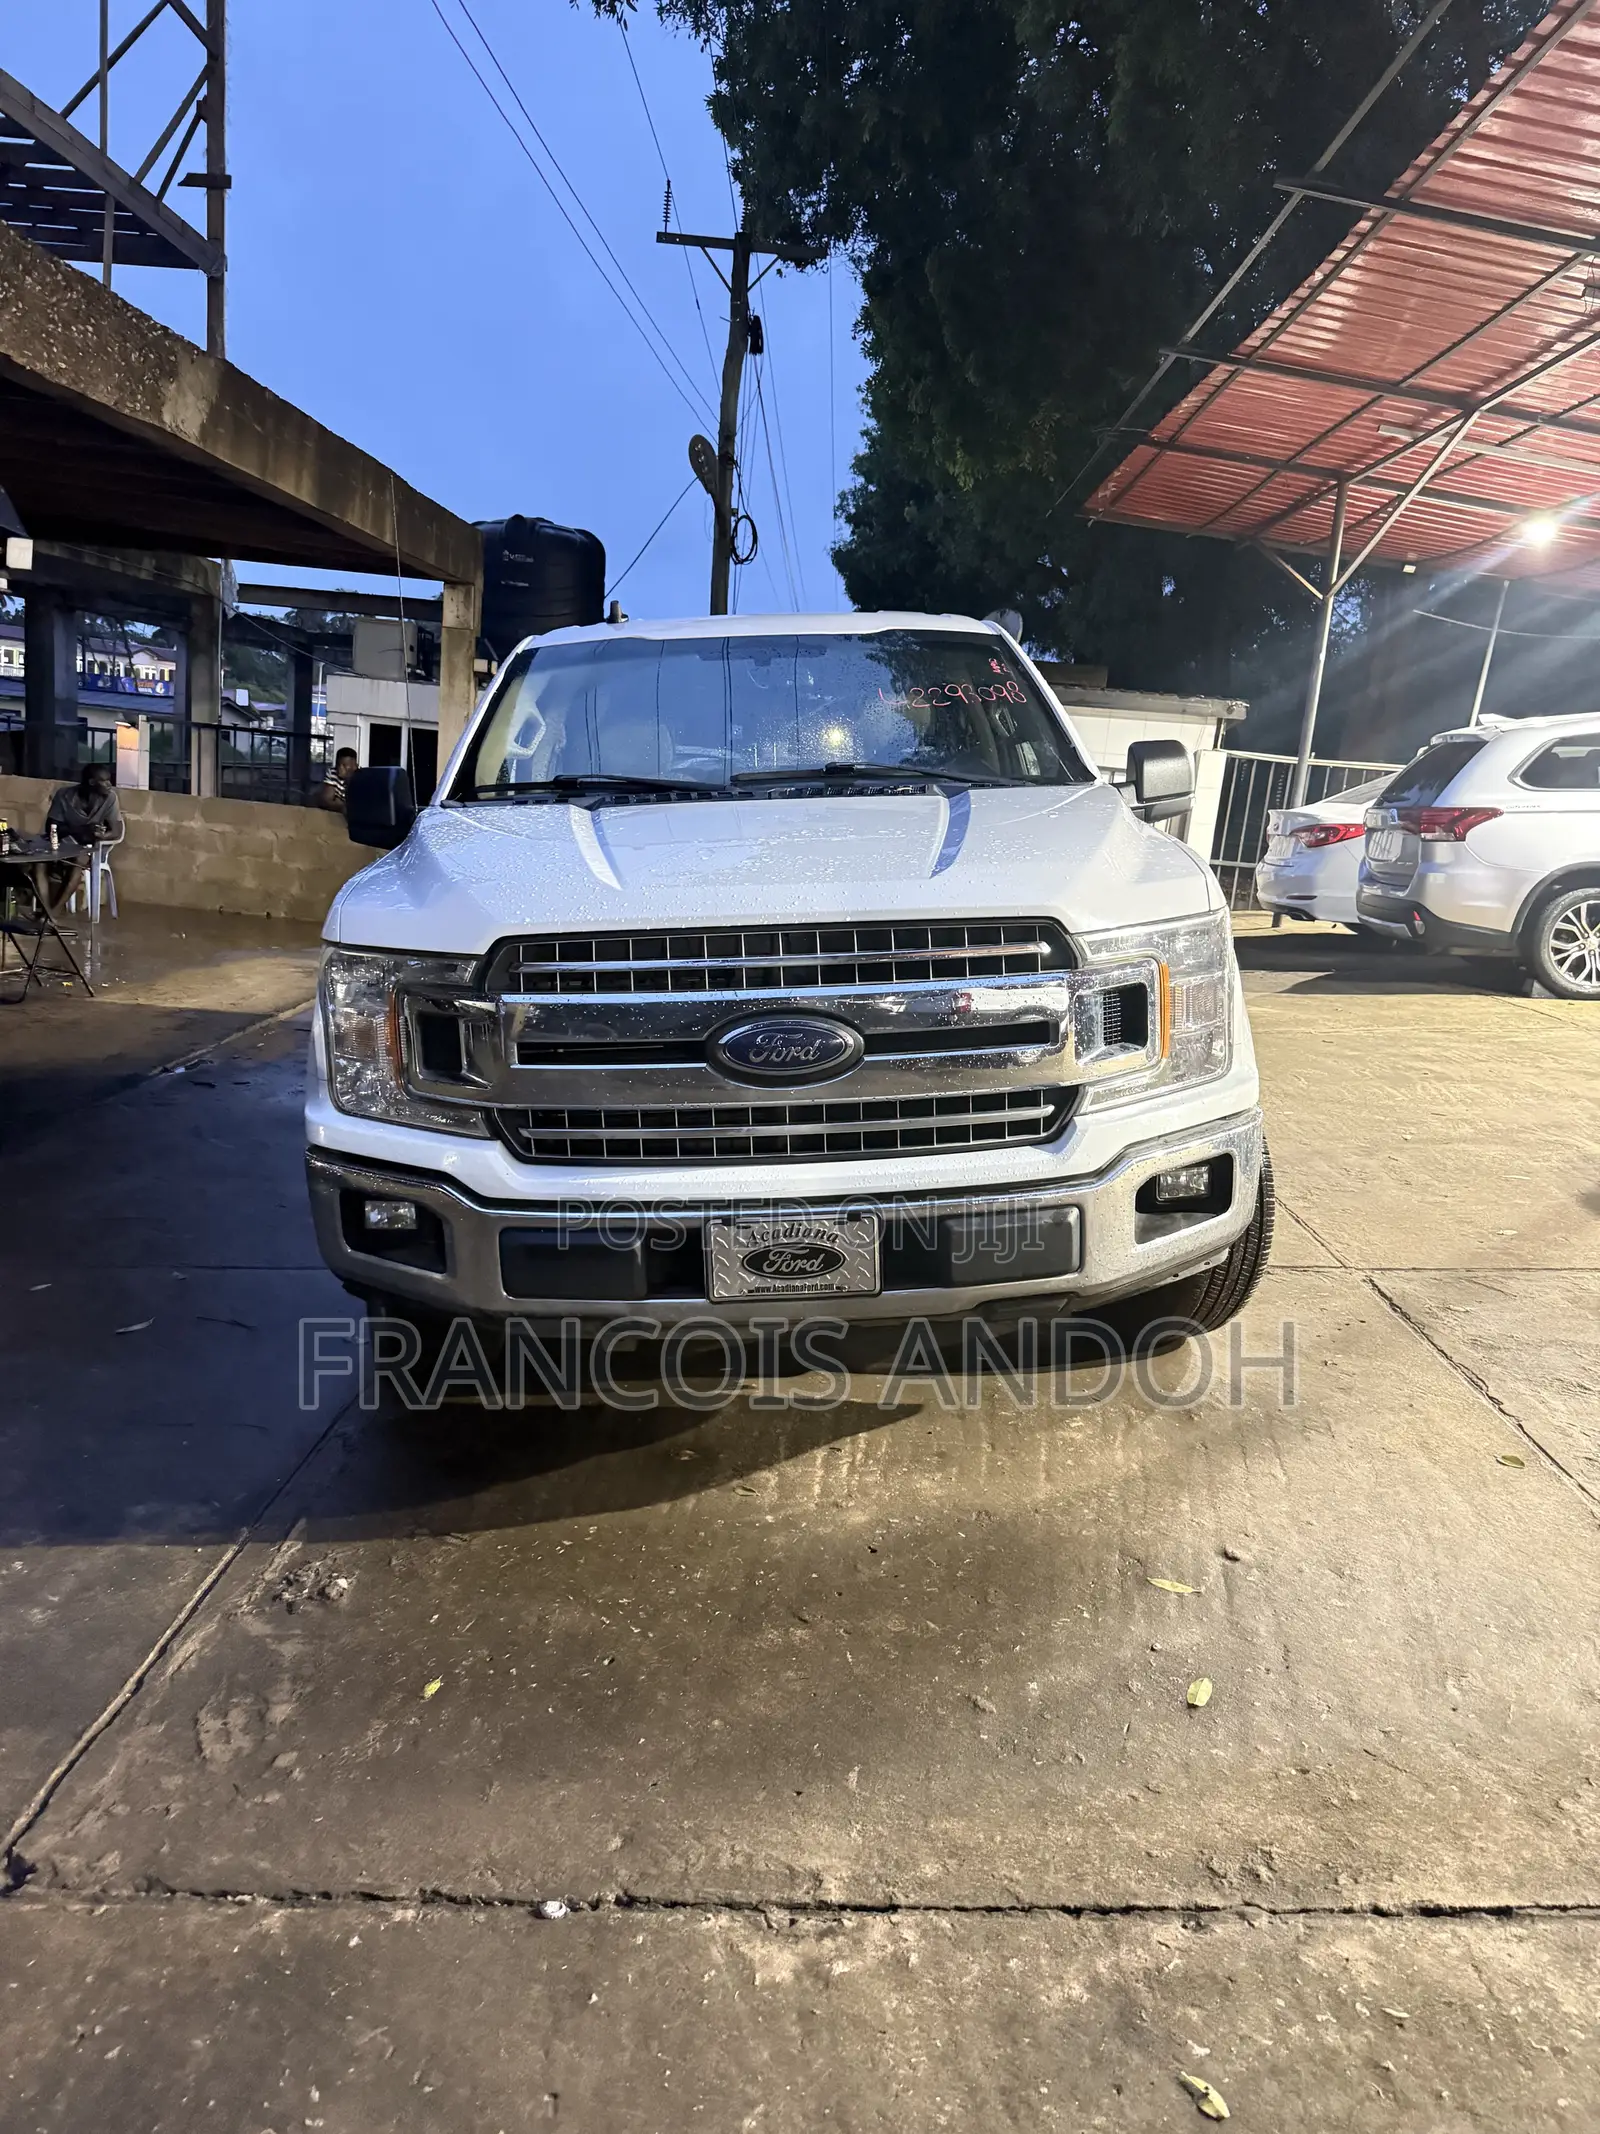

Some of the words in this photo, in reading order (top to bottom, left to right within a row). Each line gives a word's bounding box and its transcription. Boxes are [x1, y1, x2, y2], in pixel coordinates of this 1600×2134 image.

[748, 1032, 821, 1063] Ford
[746, 1222, 840, 1248] Acadiana
[763, 1248, 825, 1273] Ford
[754, 1282, 835, 1293] www.AcadianaFord.com
